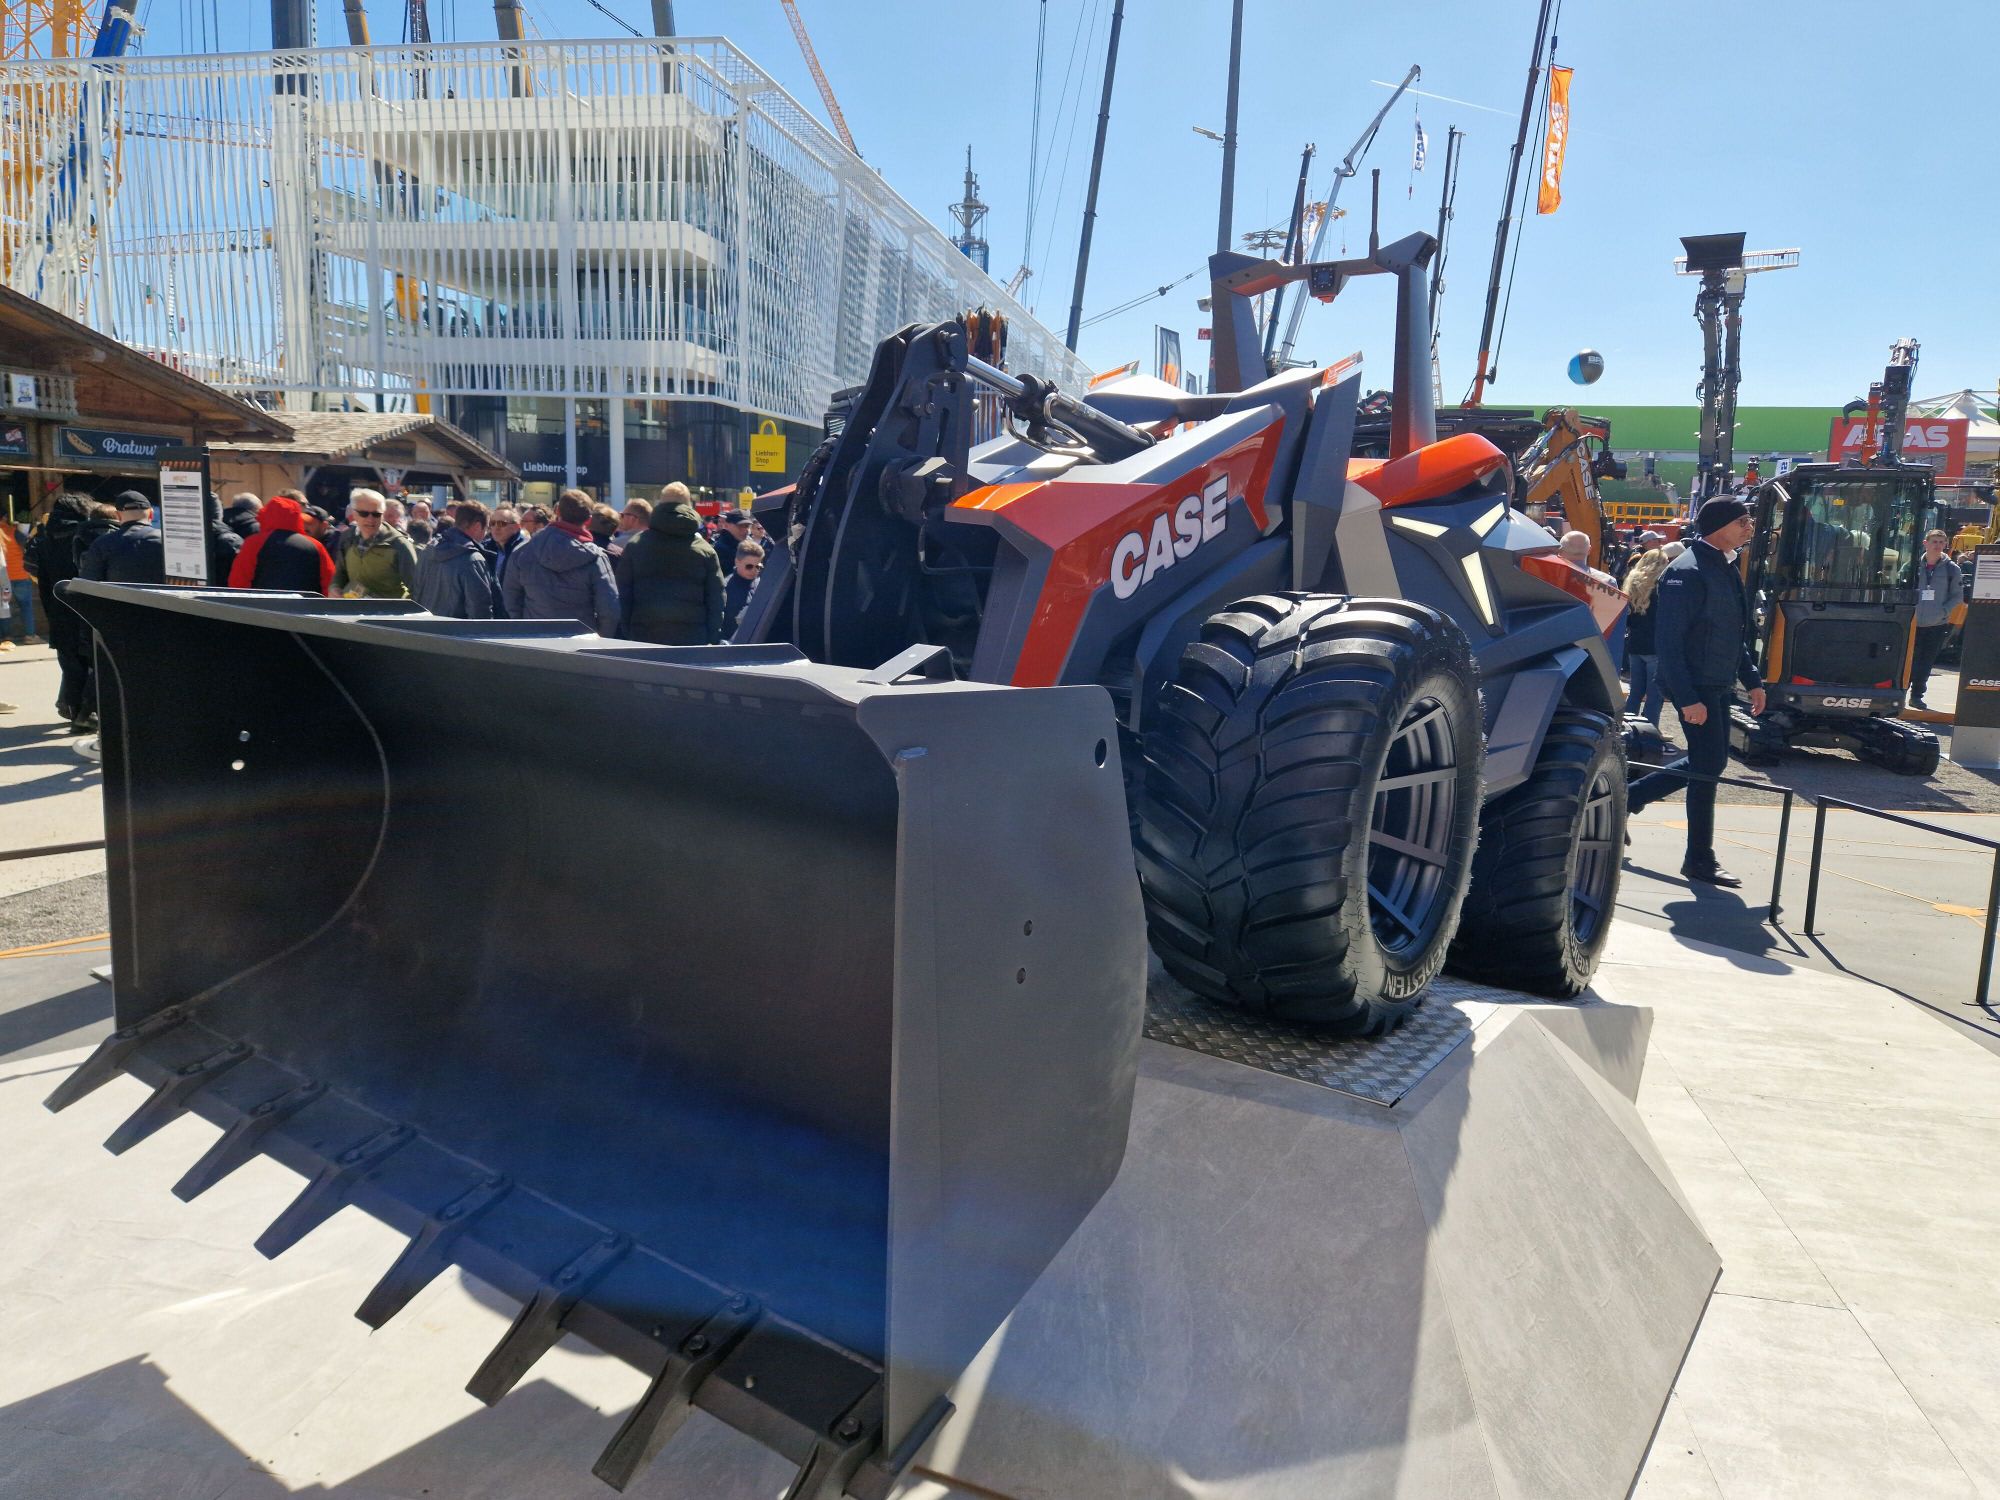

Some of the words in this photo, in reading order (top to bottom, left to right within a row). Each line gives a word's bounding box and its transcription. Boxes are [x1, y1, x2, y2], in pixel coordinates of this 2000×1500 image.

[1545, 102, 1564, 189] ATLAS
[1110, 474, 1229, 600] CASE
[1822, 696, 1872, 708] CASE
[1969, 678, 2000, 687] CASE
